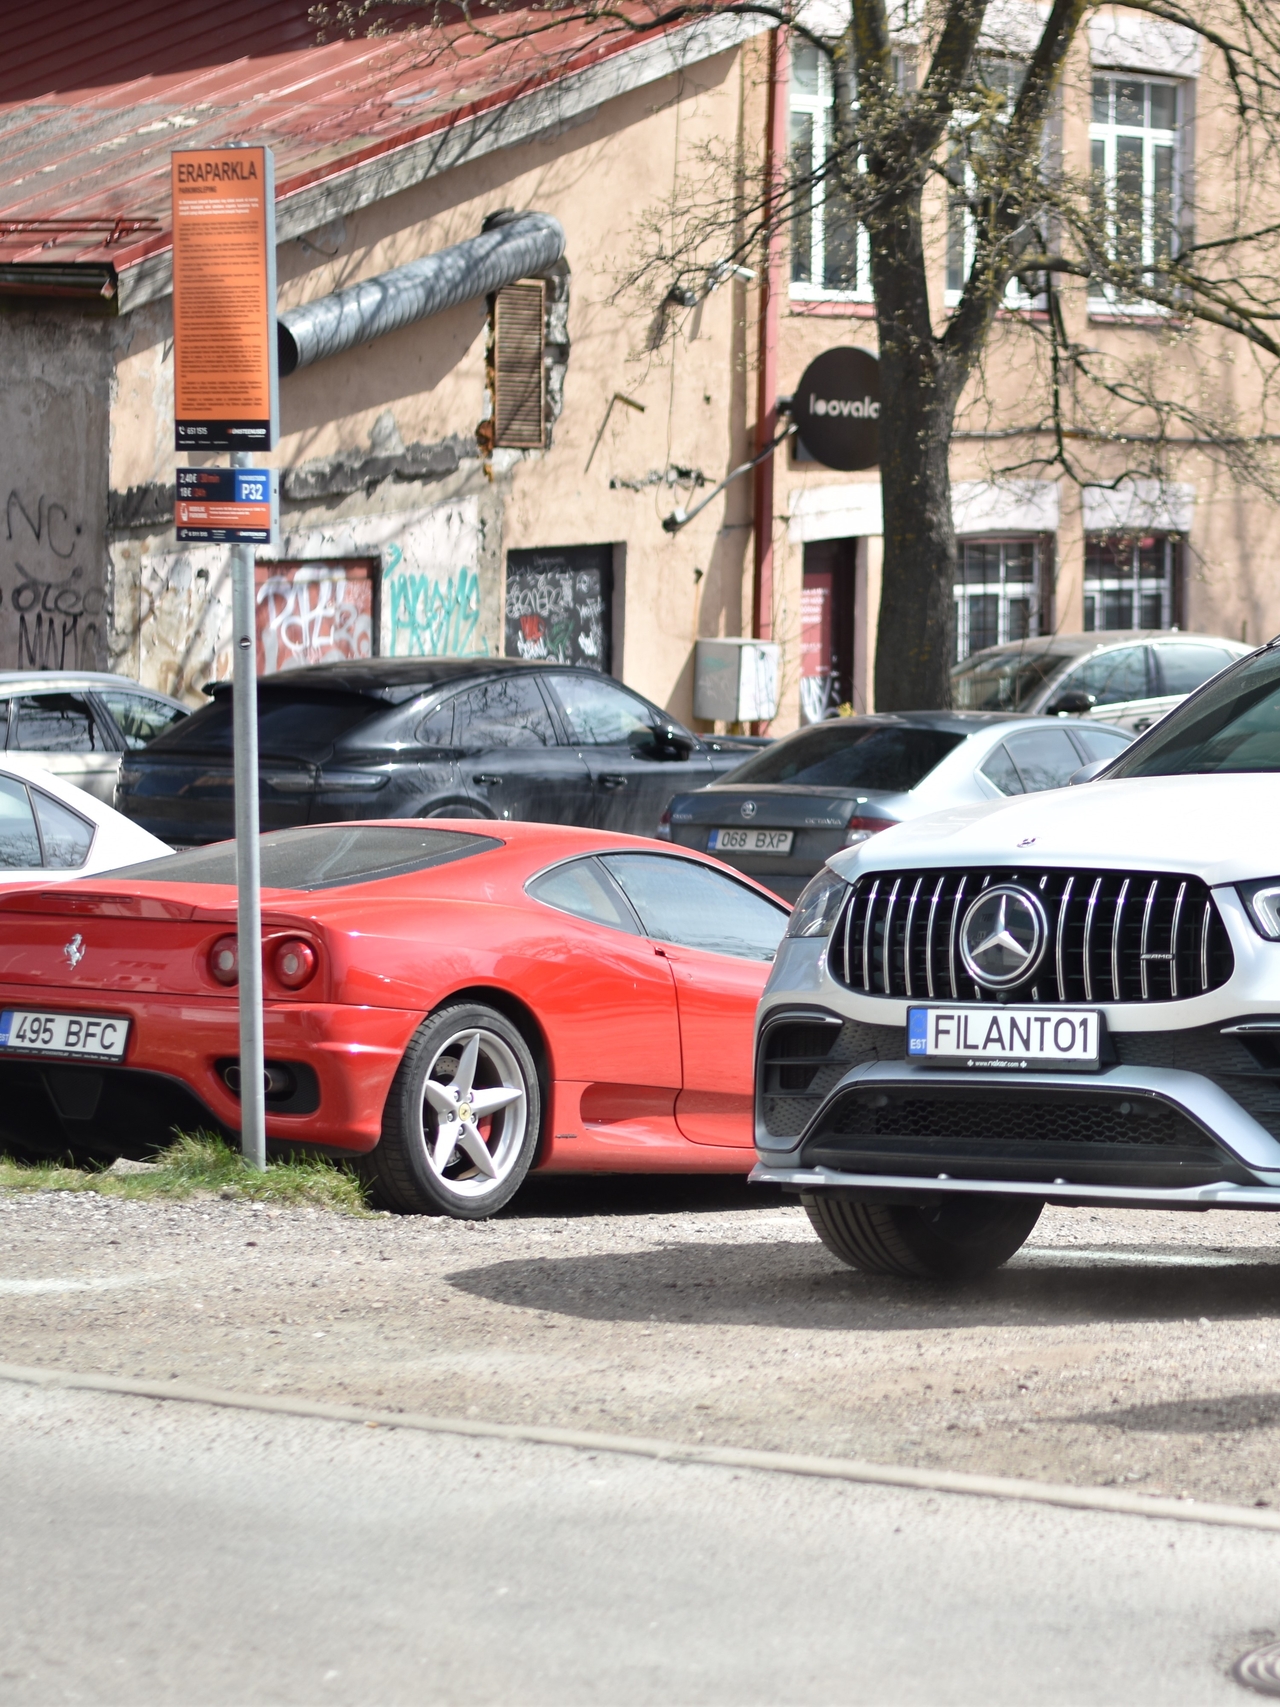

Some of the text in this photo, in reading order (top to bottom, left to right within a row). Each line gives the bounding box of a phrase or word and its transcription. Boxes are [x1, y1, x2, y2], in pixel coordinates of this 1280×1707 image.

[178, 161, 257, 183] ERAPARKLA
[242, 484, 263, 500] P32
[721, 832, 788, 849] 068 BXP
[16, 1016, 118, 1050] 495 BFC
[910, 1039, 927, 1049] EST
